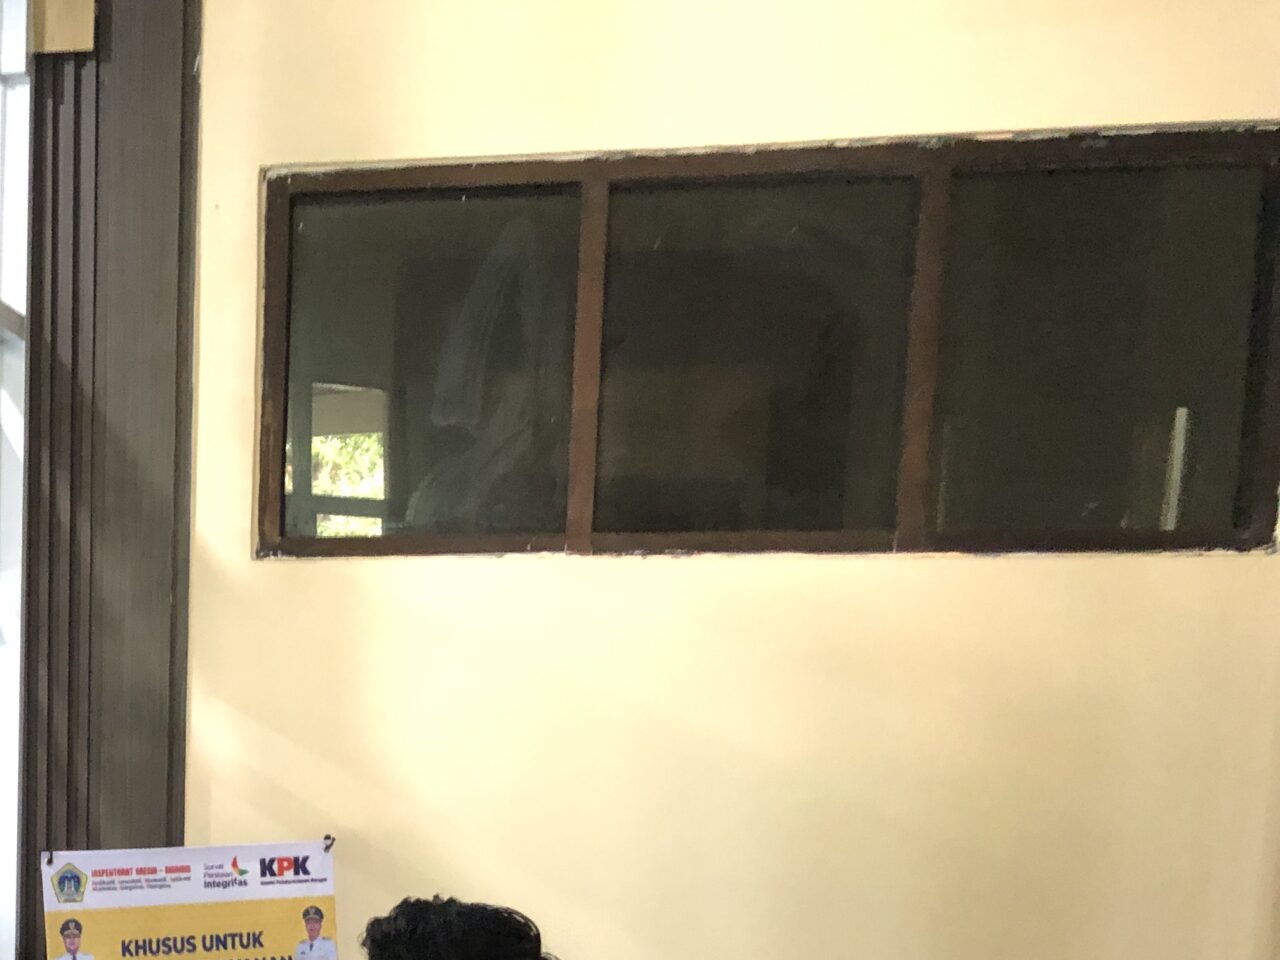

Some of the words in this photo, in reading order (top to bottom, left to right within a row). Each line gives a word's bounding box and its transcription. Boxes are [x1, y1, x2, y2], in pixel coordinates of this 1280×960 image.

[259, 855, 311, 877] KPK
[203, 877, 248, 889] Integritas
[121, 935, 196, 957] KHUSUS
[202, 931, 264, 952] UNTUK
